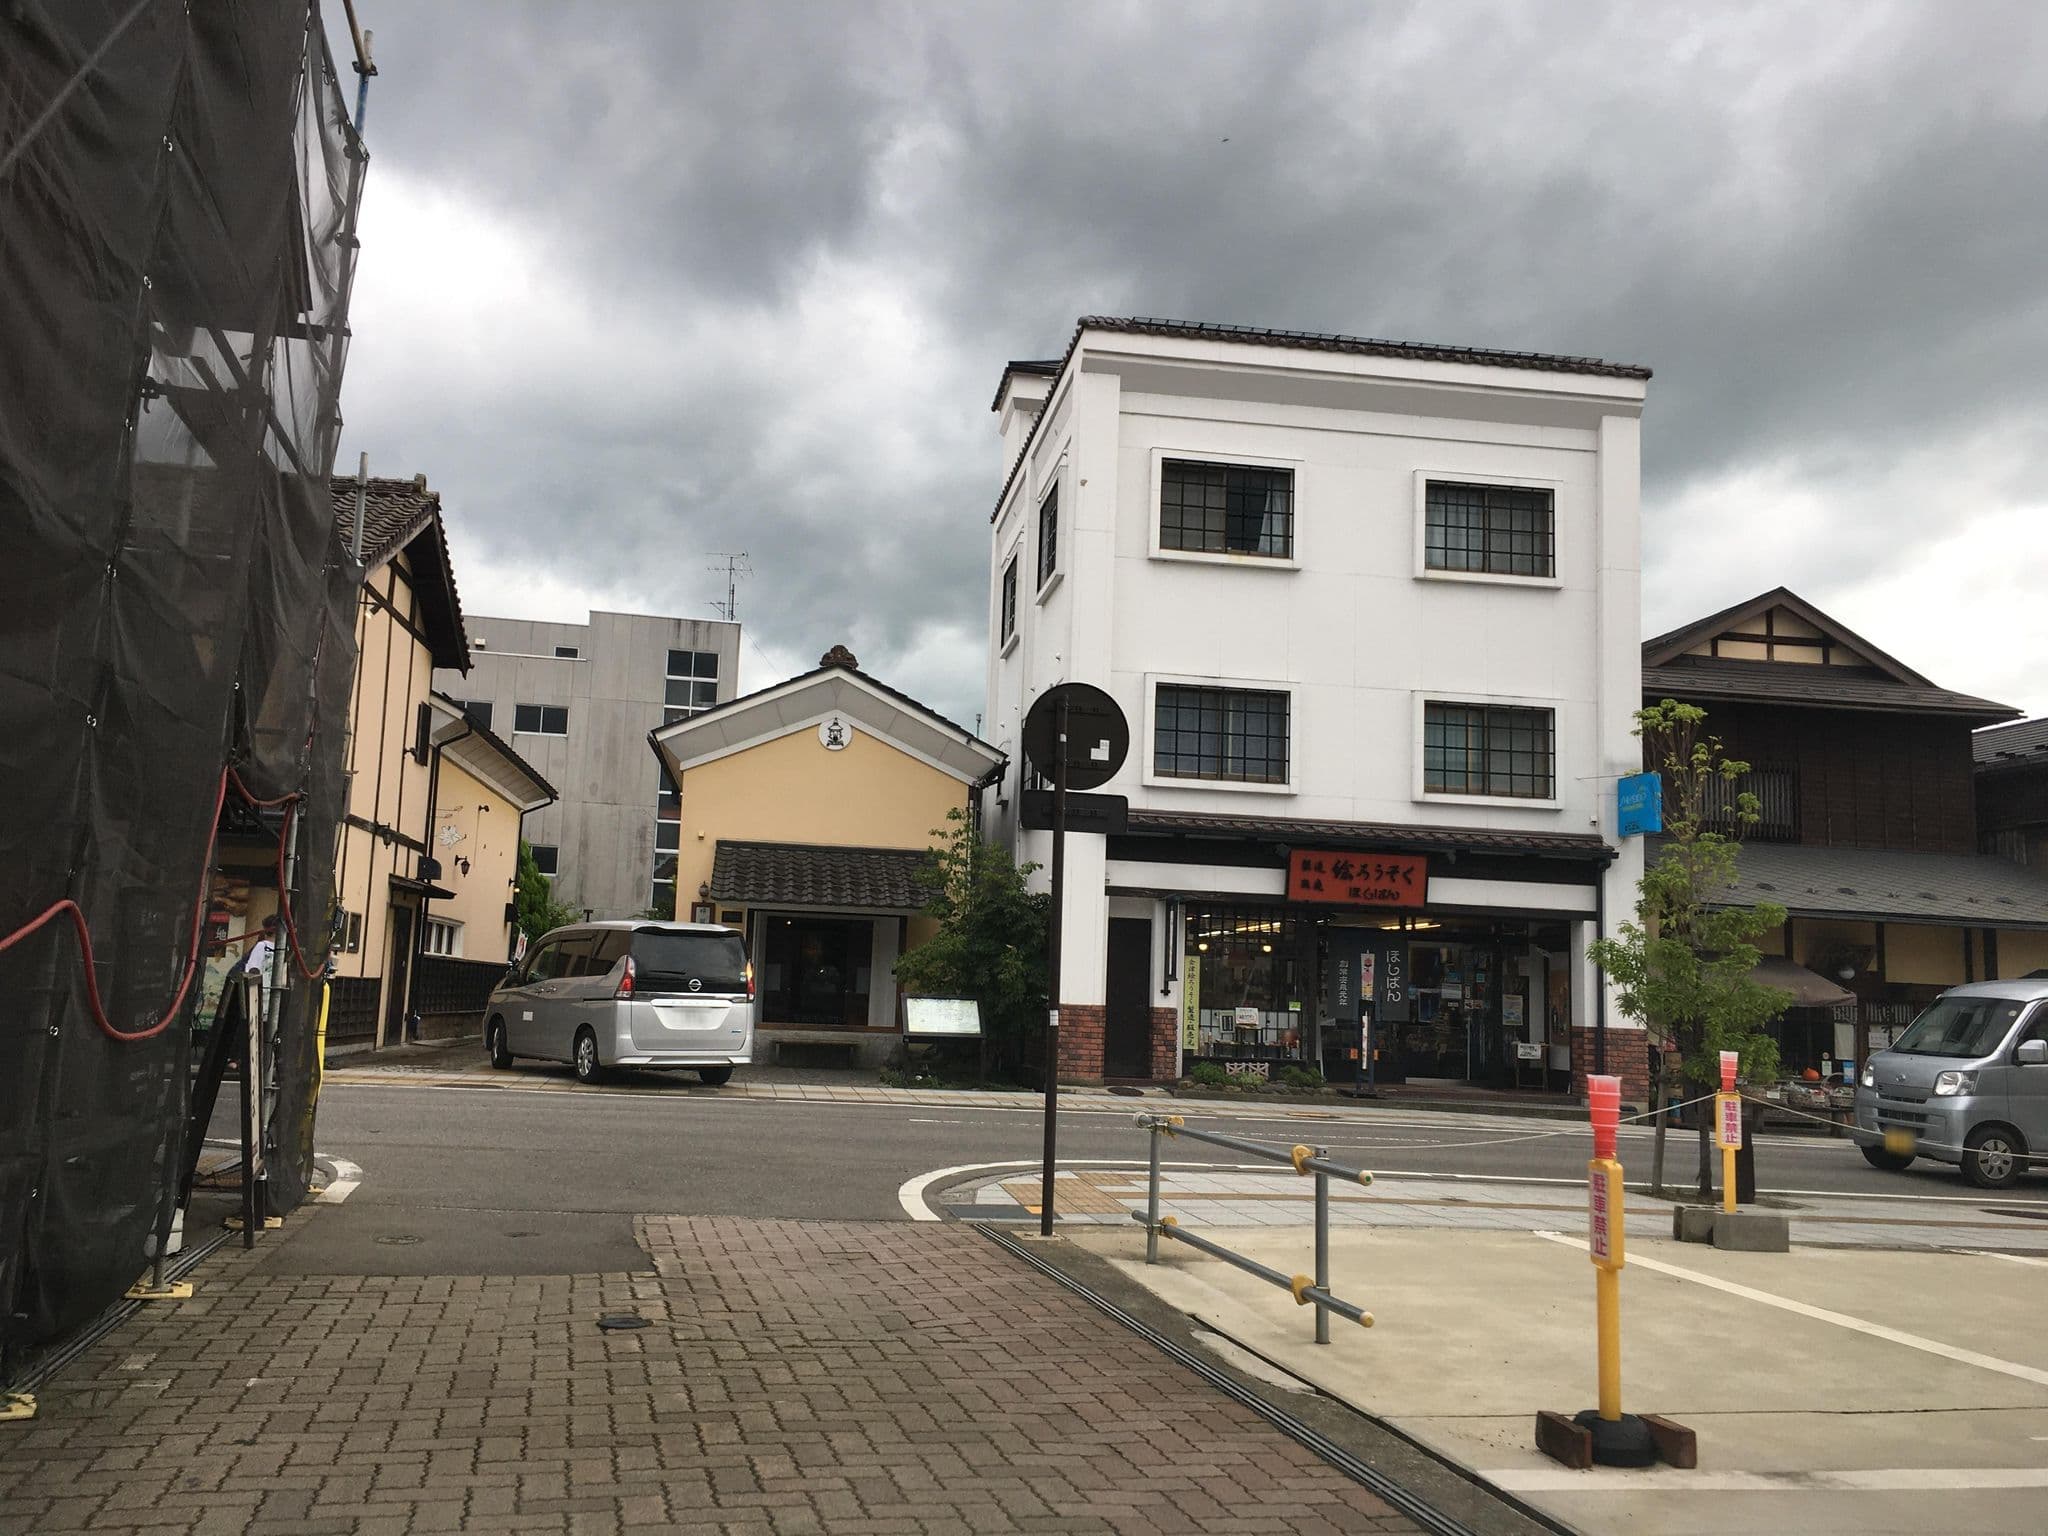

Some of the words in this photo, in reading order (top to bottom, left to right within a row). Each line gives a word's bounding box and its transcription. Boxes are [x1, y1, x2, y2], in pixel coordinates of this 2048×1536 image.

[1385, 949, 1402, 1003] ほしばん
[1725, 1101, 1738, 1144] 駐車禁止
[1592, 1173, 1608, 1257] 駐車禁止
